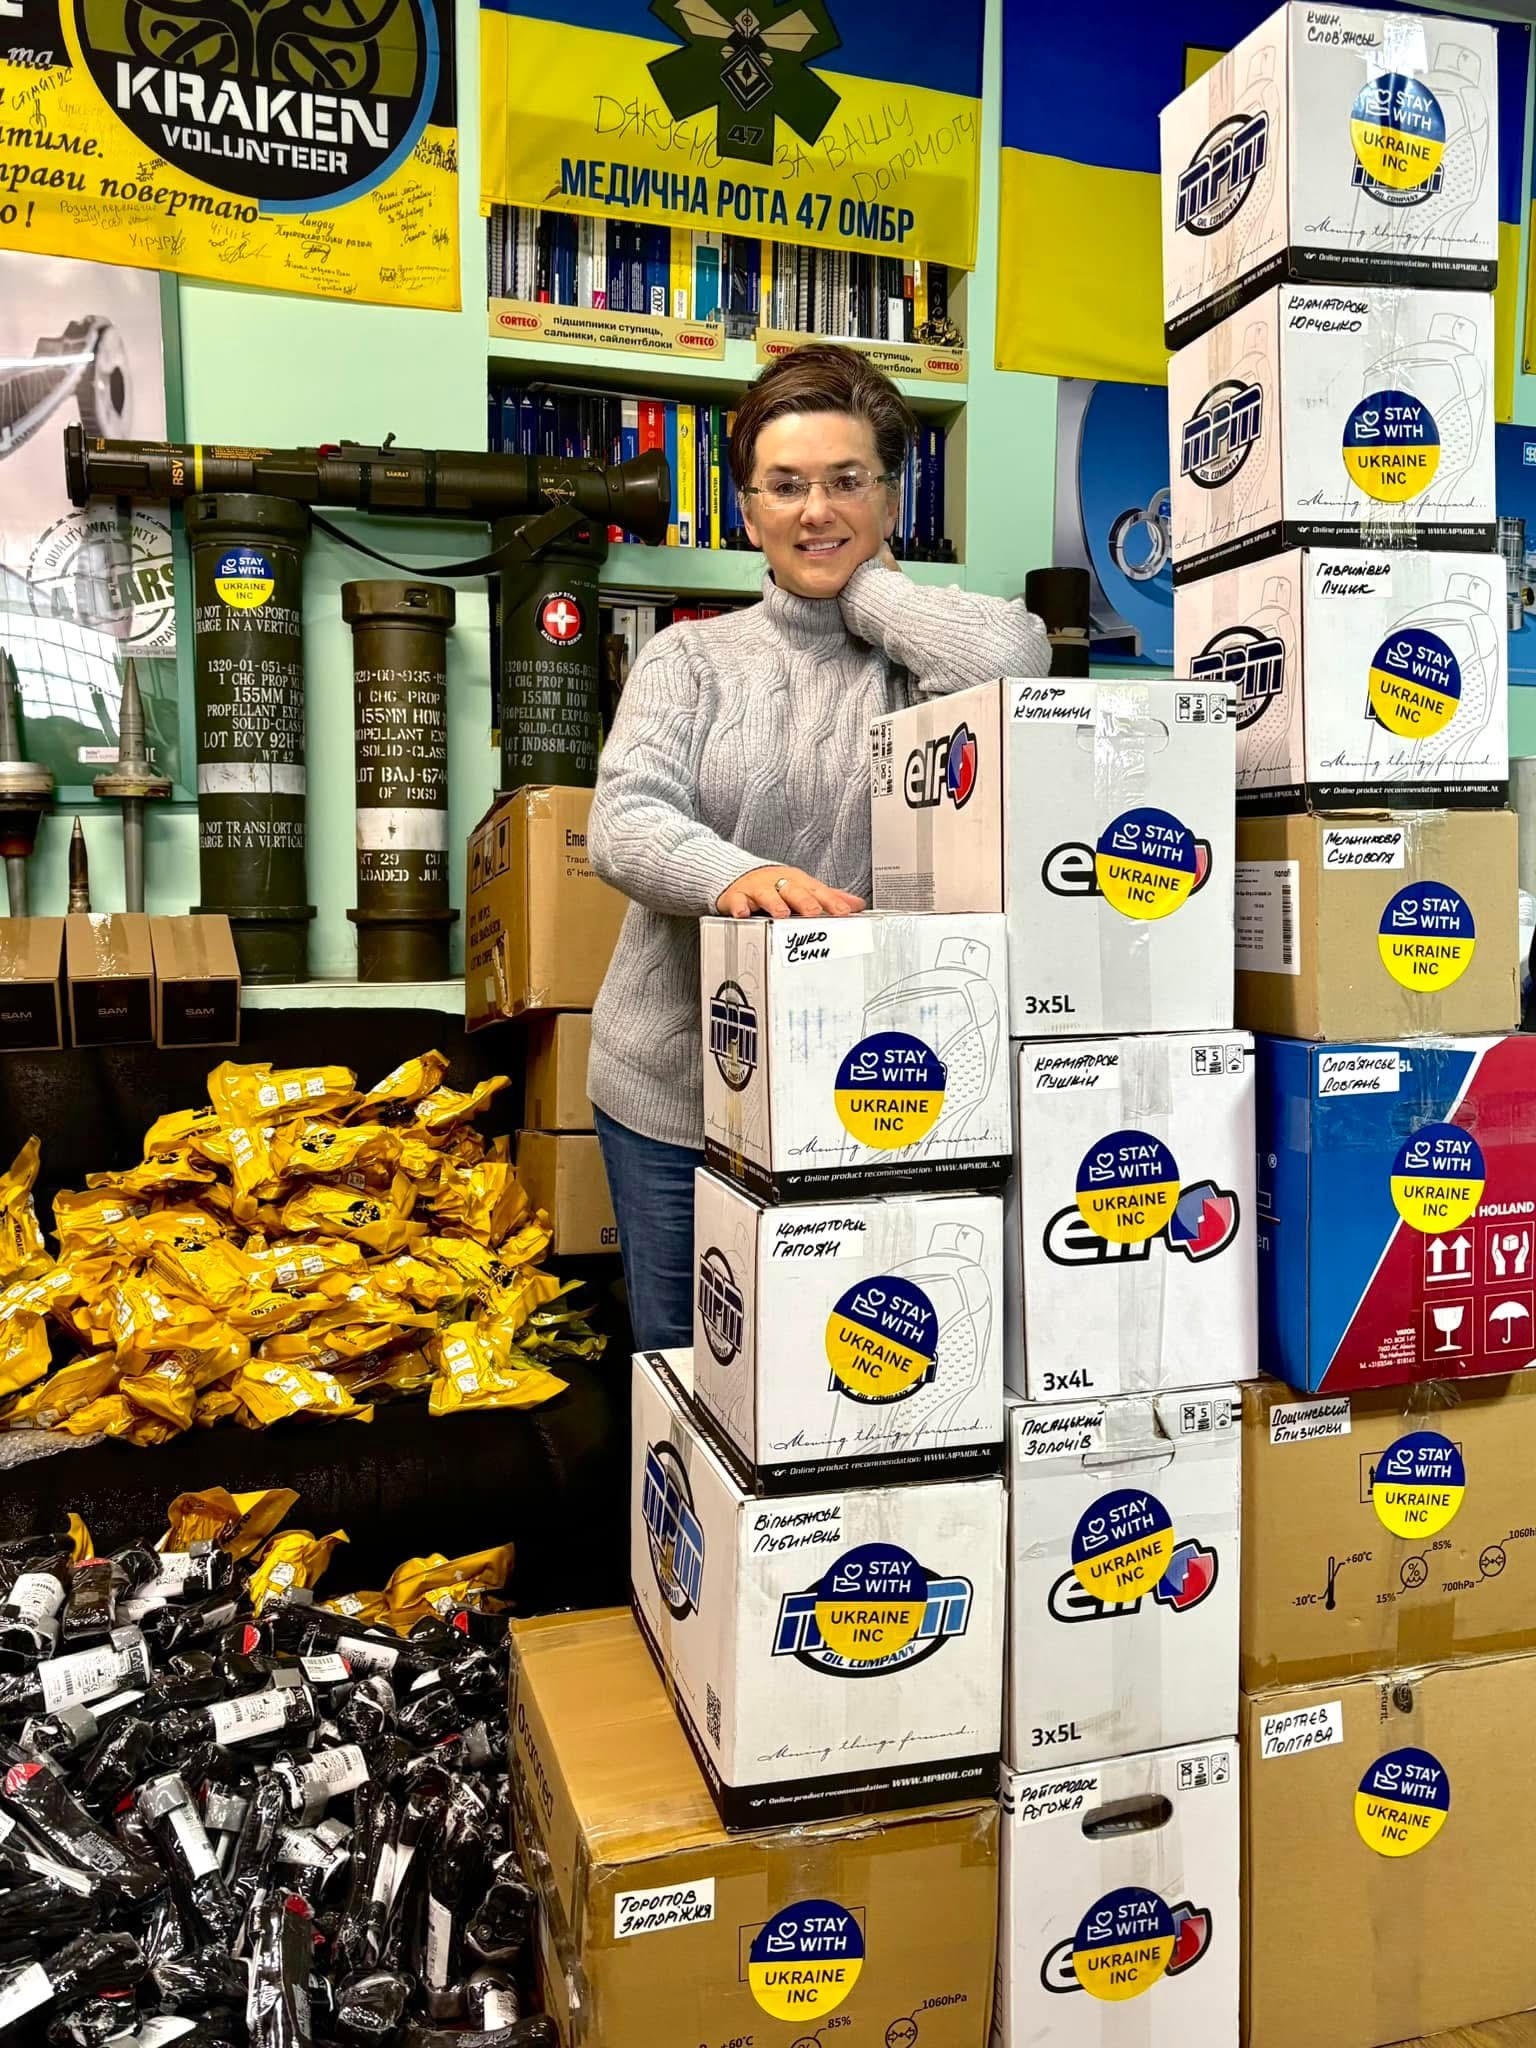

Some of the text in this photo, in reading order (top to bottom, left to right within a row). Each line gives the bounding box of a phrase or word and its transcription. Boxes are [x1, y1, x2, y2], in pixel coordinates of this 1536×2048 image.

[8, 46, 53, 72] та
[116, 61, 390, 150] KRAKEN
[1395, 91, 1433, 114] STAY
[1392, 108, 1432, 132] WITH
[728, 125, 765, 145] 47
[776, 144, 811, 179] ЗА
[818, 99, 914, 171] ВАШУ
[161, 123, 348, 175] VOLUNTEER
[1364, 131, 1431, 161] UKRAINE
[1382, 153, 1408, 172] INC
[561, 159, 915, 245] МЕДИЧНА РОТА 47 ОМБР
[652, 288, 663, 312] 2009
[500, 315, 538, 328] CORTECO
[553, 317, 663, 337] підшипники ступиць,
[544, 328, 673, 350] сальники, сайлентблоки
[679, 334, 715, 346] CORTECO
[873, 352, 913, 364] ступиць,
[927, 361, 960, 371] CORTECO
[1384, 408, 1421, 421] STAY
[1384, 424, 1424, 438] WITH
[1357, 454, 1427, 468] UKRAINE
[172, 460, 184, 487] RSV
[1381, 472, 1407, 485] INC
[44, 528, 85, 567] QUALITY
[238, 557, 263, 567] STAY
[238, 566, 265, 576] WITH
[223, 582, 266, 592] UKRAINE
[236, 592, 253, 600] INC
[1416, 646, 1453, 669] STAY
[232, 673, 288, 688] CHG PROP
[1411, 662, 1450, 687] WITH
[233, 687, 284, 704] 155MM
[522, 691, 561, 706] 155MM
[1380, 680, 1445, 714] UKRAINE
[207, 704, 279, 718] PROPELLANT
[361, 708, 406, 725] 155MM
[1395, 703, 1421, 723] INC
[204, 731, 265, 748] LOT ECY
[406, 786, 437, 801] 1969
[1145, 825, 1184, 843] STAY
[1141, 841, 1183, 862] WITH
[1109, 866, 1180, 892] UKRAINE
[1128, 887, 1156, 904] INC
[1422, 899, 1460, 913] STAY
[1420, 914, 1460, 930] WITH
[1393, 944, 1460, 959] UKRAINE
[1413, 962, 1438, 975] INC
[98, 1007, 128, 1015] SAM
[1025, 995, 1076, 1014] 3x5L
[884, 1050, 926, 1064] STAY
[881, 1068, 927, 1082] WITH
[850, 1100, 929, 1113] UKRAINE
[874, 1118, 904, 1131] INC
[1118, 1144, 1159, 1161] STAY
[1434, 1139, 1472, 1154] STAY
[1118, 1163, 1162, 1180] WITH
[1432, 1157, 1471, 1172] WITH
[1404, 1185, 1470, 1201] UKRAINE
[1093, 1192, 1166, 1212] UKRAINE
[1423, 1203, 1448, 1217] INC
[1479, 1202, 1535, 1217] HOLLAND
[1117, 1211, 1144, 1227] INC
[889, 1297, 931, 1324] STAY
[881, 1314, 924, 1343] WITH
[839, 1328, 913, 1373] UKRAINE
[852, 1356, 882, 1378] INC
[1043, 1369, 1093, 1391] 3x4L
[1418, 1448, 1452, 1461] STAY
[1416, 1464, 1452, 1478] WITH
[1386, 1492, 1450, 1506] UKRAINE
[1109, 1498, 1149, 1523] STAY
[1404, 1510, 1428, 1522] INC
[1112, 1514, 1154, 1539] WITH
[1432, 1540, 1452, 1550] 85%
[1091, 1541, 1163, 1578] UKRAINE
[1346, 1552, 1372, 1563] +60°C
[869, 1561, 913, 1576] STAY
[1116, 1566, 1145, 1587] INC
[865, 1578, 912, 1593] WITH
[1442, 1580, 1474, 1592] 700hPa
[1292, 1594, 1316, 1606] -10°C
[1376, 1592, 1396, 1604] 15%
[831, 1610, 910, 1625] UKRAINE
[853, 1628, 883, 1642] INC
[822, 1643, 918, 1669] OIL COMPANY
[1031, 1723, 1081, 1747] 3x5L
[892, 1768, 982, 1788] WWW.MPMOIL.COM
[1405, 1765, 1440, 1782] STAY
[1401, 1781, 1437, 1799] WITH
[1367, 1803, 1431, 1828] UKRAINE
[1382, 1825, 1408, 1841] INC
[1118, 1900, 1158, 1918] STAY
[803, 1917, 849, 1933] STAY
[1116, 1918, 1159, 1937] WITH
[800, 1935, 847, 1953] WITH
[1088, 1947, 1161, 1971] UKRAINE
[765, 1969, 846, 1986] UKRAINE
[1110, 1968, 1139, 1984] INC
[787, 1987, 819, 2004] INC
[922, 1993, 968, 2011] 1060hPa
